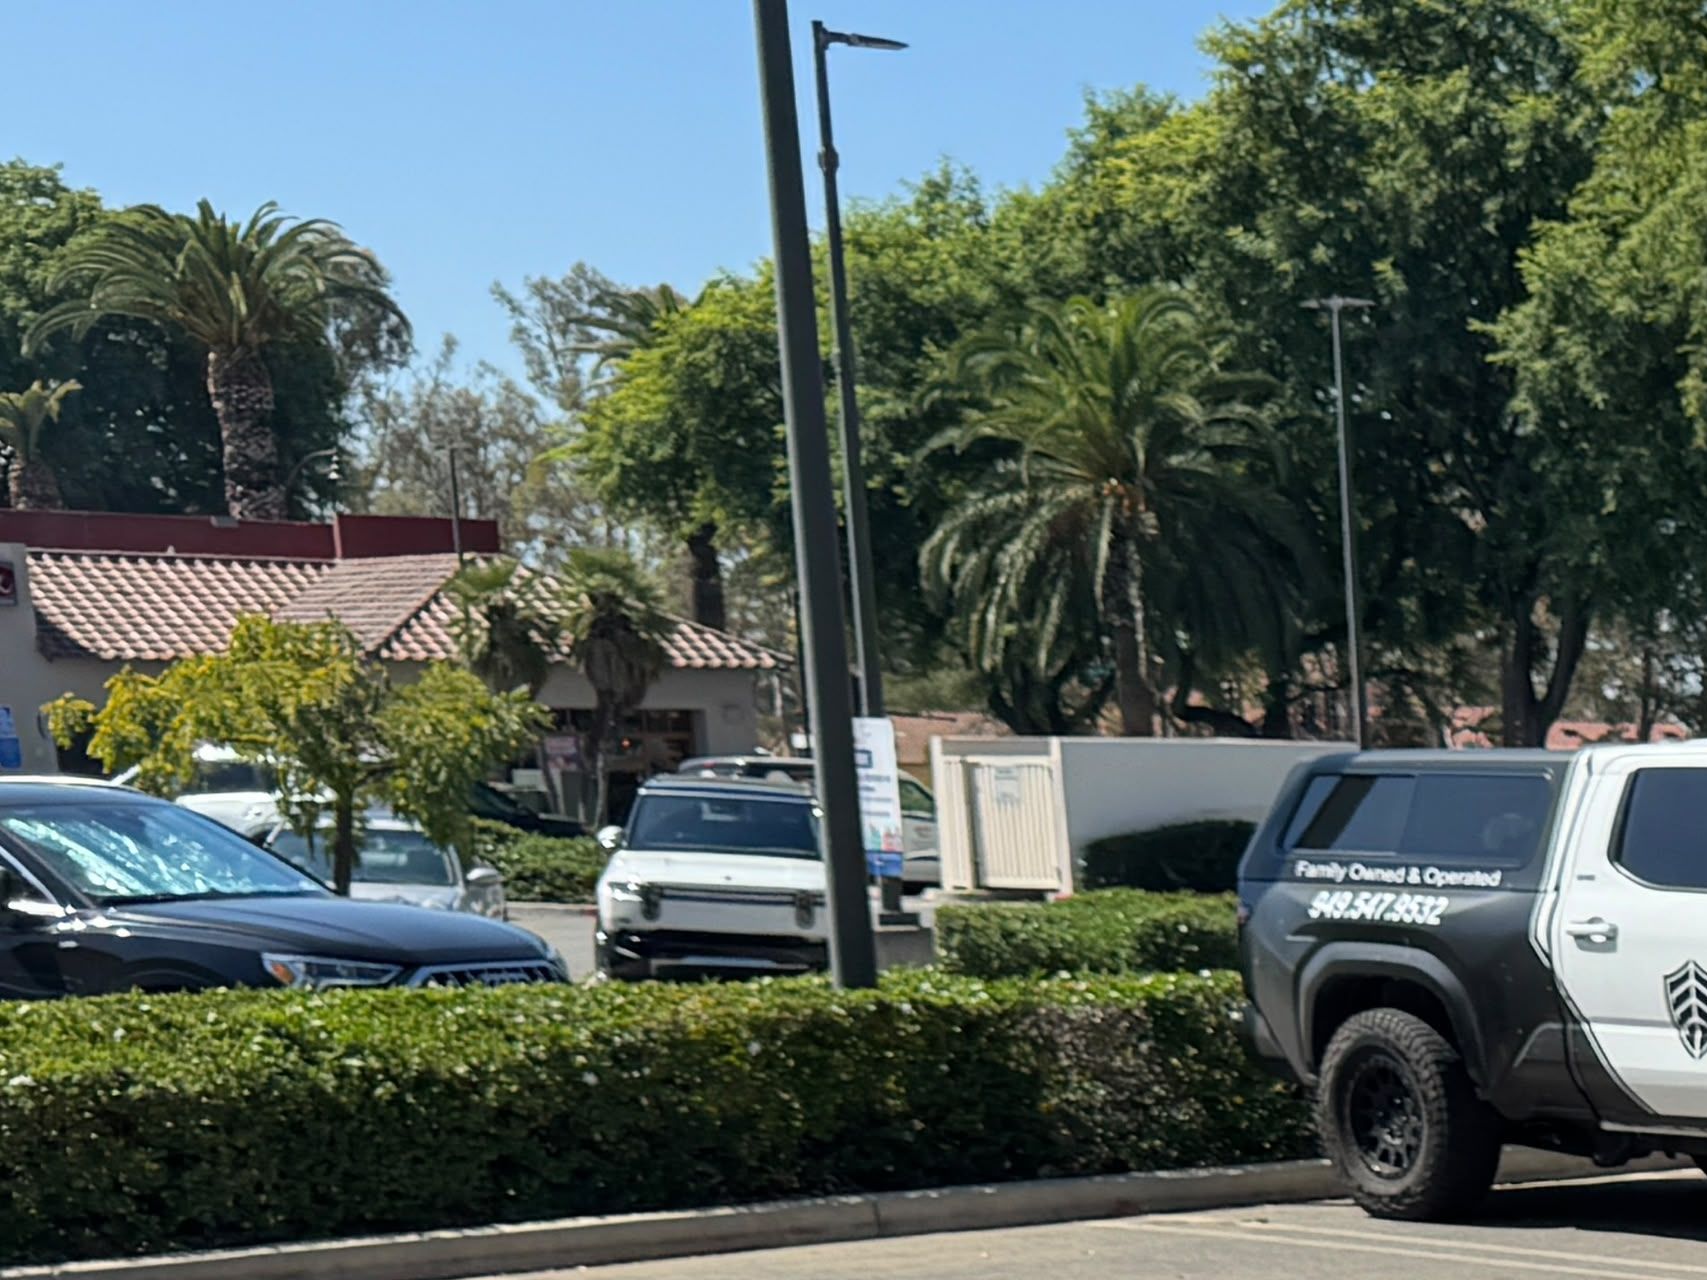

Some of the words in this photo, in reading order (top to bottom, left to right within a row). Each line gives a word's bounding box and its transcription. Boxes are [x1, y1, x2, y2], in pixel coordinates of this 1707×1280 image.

[1294, 859, 1347, 883] Family
[1349, 862, 1406, 884] Owned
[1407, 866, 1421, 885] &
[1423, 866, 1502, 888] Operated
